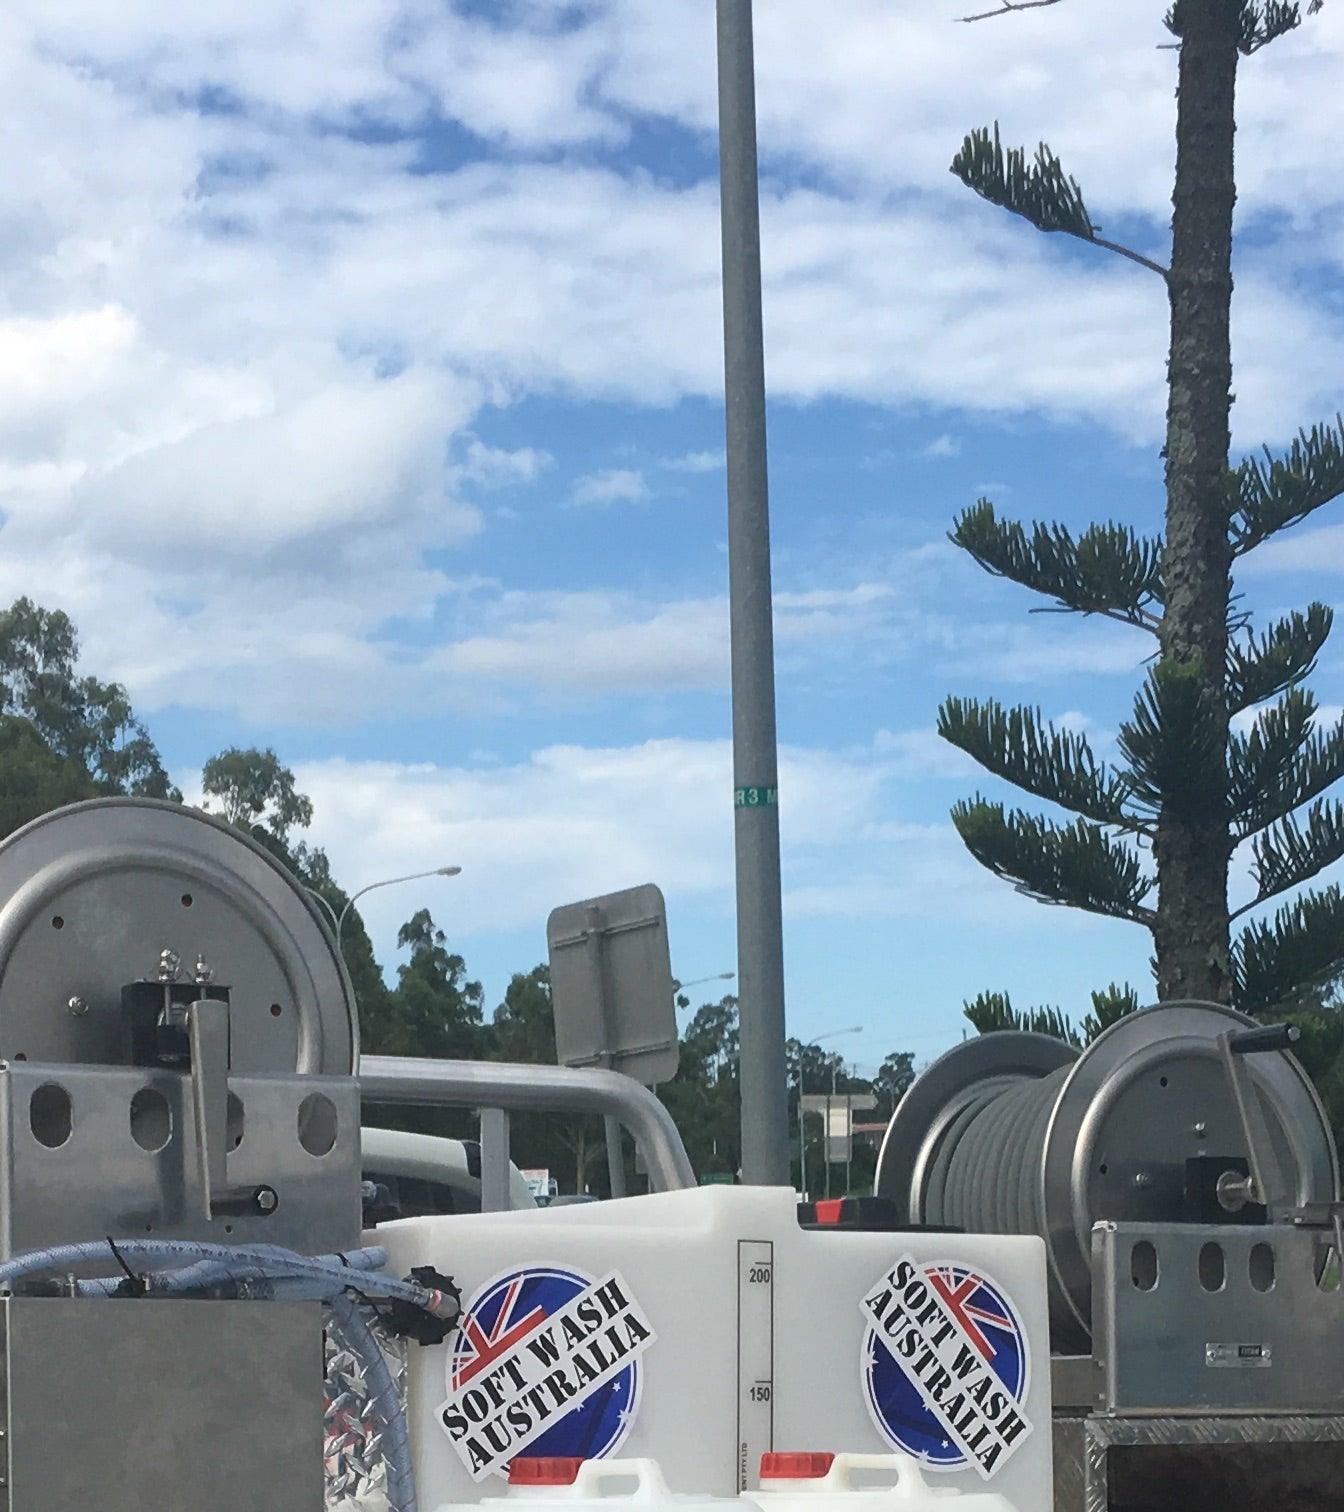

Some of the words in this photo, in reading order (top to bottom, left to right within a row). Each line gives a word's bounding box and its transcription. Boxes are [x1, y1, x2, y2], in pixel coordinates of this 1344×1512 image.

[749, 1268, 770, 1283] 200
[888, 1261, 958, 1349] SOFT
[950, 1342, 1026, 1447] WASH
[442, 1355, 528, 1442] SOFT
[526, 1277, 630, 1368] WASH
[465, 1313, 651, 1474] AUSTRALIA
[750, 1386, 770, 1402] 150
[865, 1289, 1003, 1474] AUSTRALIA
